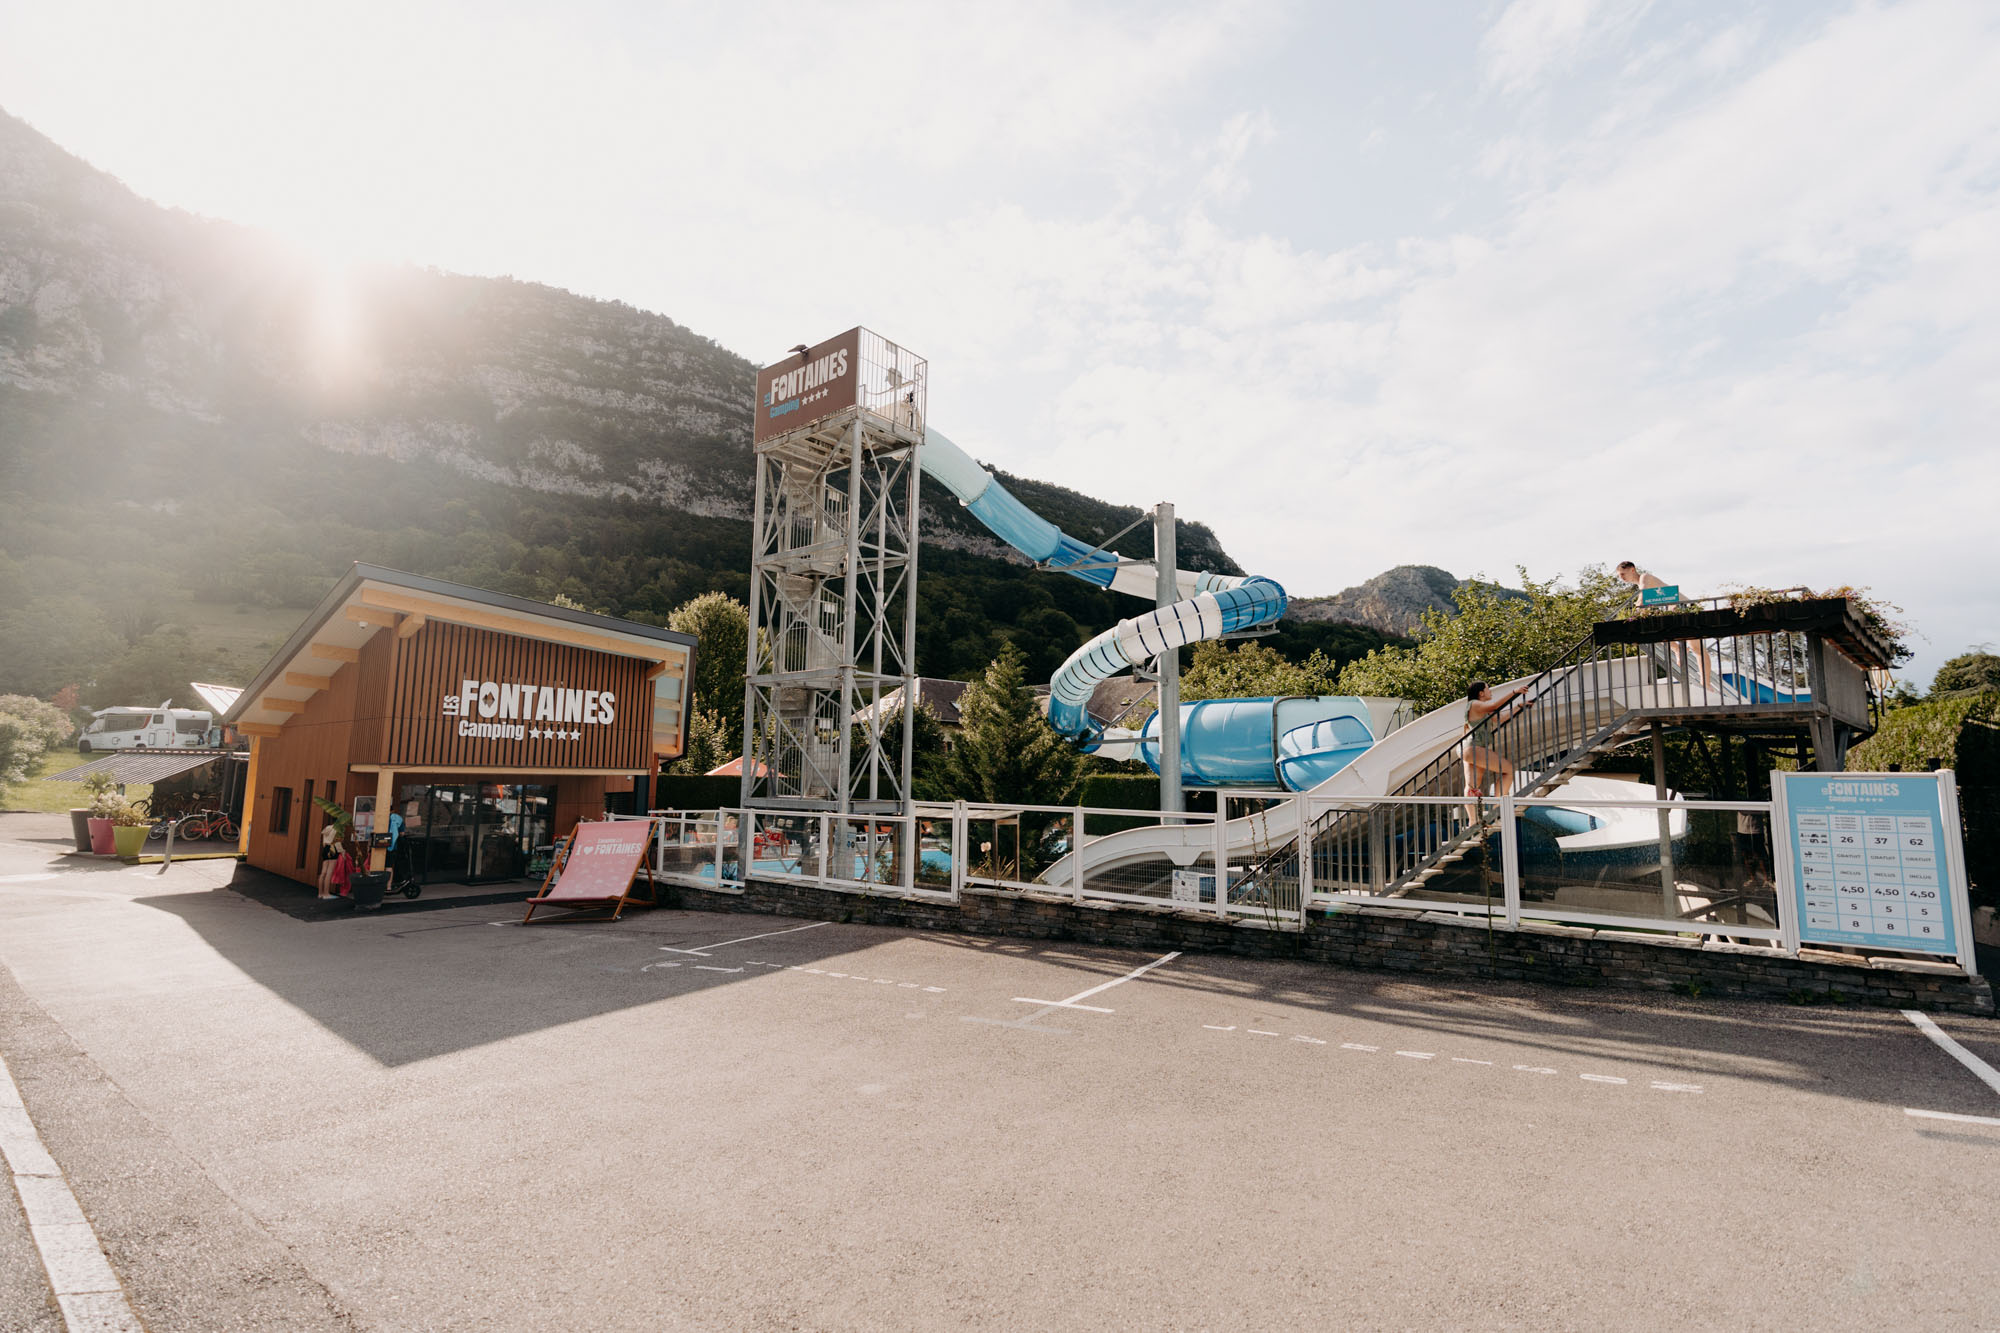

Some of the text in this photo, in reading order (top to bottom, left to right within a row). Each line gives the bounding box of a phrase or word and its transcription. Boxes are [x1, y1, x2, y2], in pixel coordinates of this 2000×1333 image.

[770, 348, 848, 405] FONTAINES
[769, 398, 800, 418] Camping
[442, 679, 615, 725] LES FONTAINES
[458, 720, 525, 741] Camping
[1828, 782, 1899, 797] FONTAINES
[1874, 837, 1888, 845] 37
[1909, 838, 1924, 846] 62
[593, 842, 642, 856] FONTAINES
[1840, 885, 1865, 894] 4,50
[1874, 888, 1899, 896] 4,50
[1910, 891, 1935, 899] 4,50
[1921, 908, 1928, 916] 5
[1852, 920, 1860, 928] 8
[1887, 923, 1894, 931] 8
[1922, 926, 1930, 934] 8
